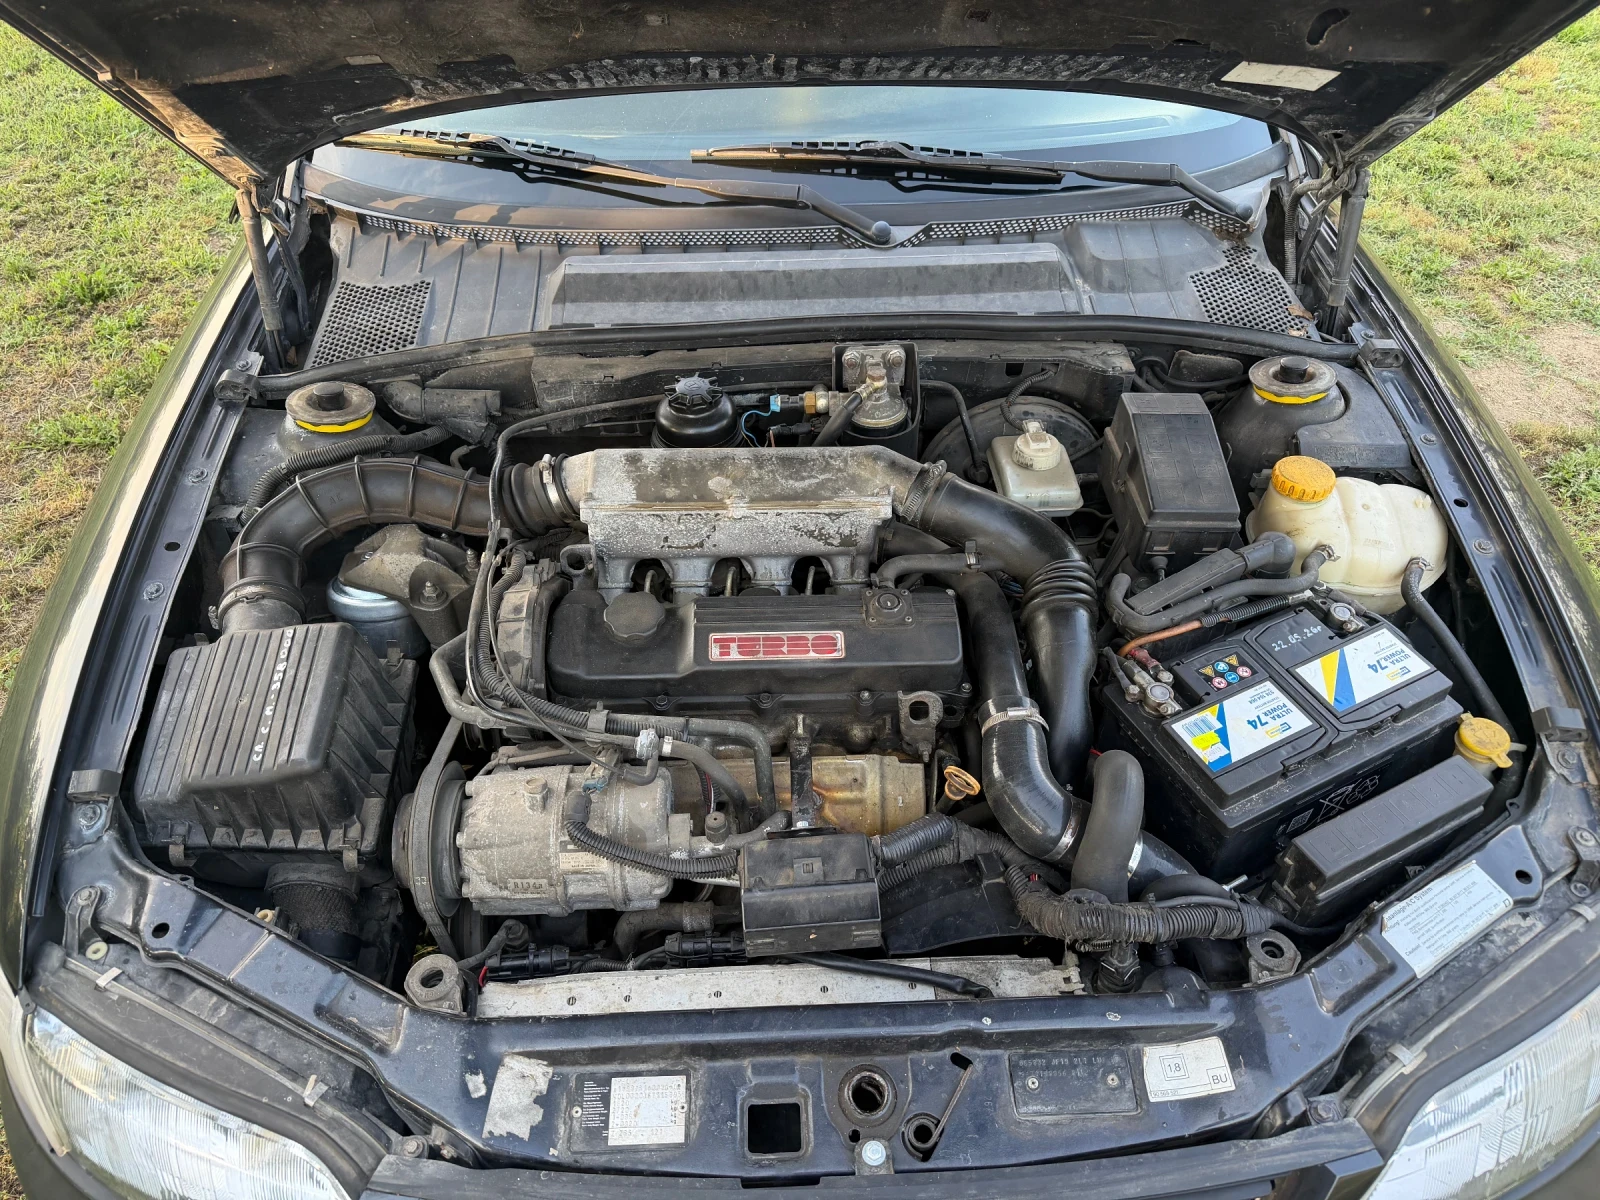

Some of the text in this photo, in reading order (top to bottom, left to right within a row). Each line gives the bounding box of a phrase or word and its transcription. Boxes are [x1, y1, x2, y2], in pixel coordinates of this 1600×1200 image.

[713, 634, 838, 657] TURBO
[1382, 648, 1405, 663] POWER
[1390, 653, 1412, 666] ULTRA
[1367, 659, 1389, 674] 74
[1262, 702, 1288, 717] POWER
[1272, 708, 1293, 721] ULTRA
[1247, 714, 1269, 730] 74
[1212, 1072, 1229, 1086] BU
